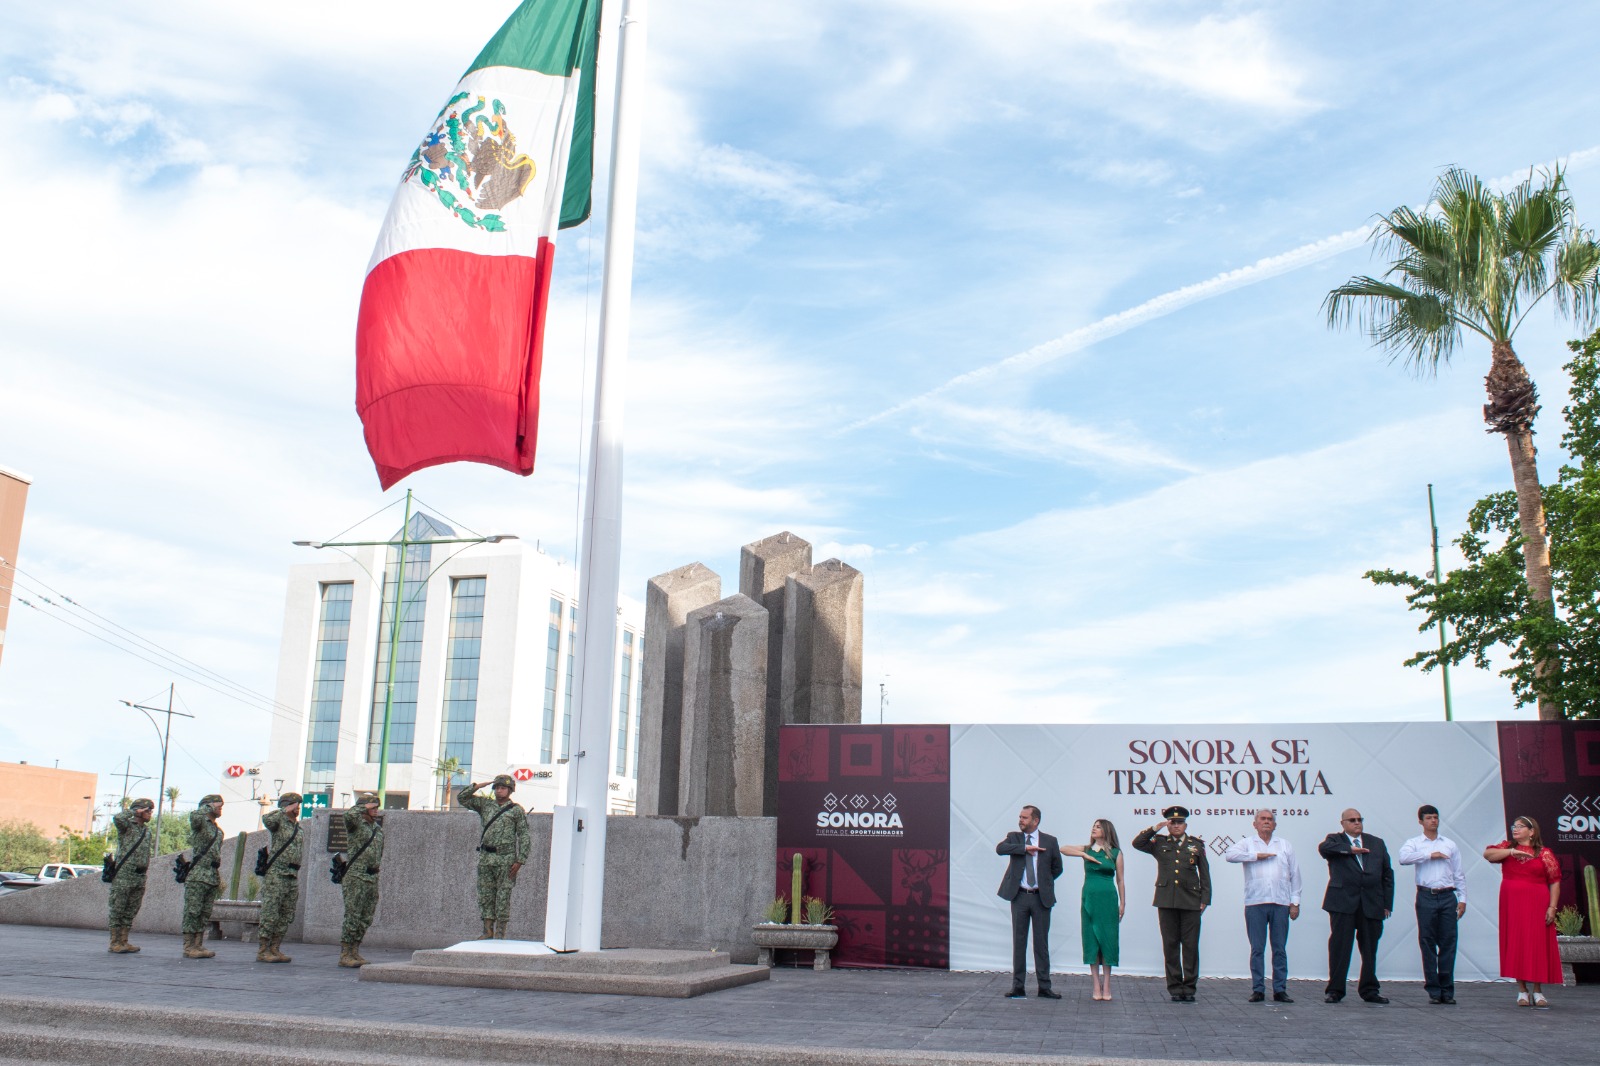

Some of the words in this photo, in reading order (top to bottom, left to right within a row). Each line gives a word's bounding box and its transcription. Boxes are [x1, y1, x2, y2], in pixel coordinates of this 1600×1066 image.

[1128, 739, 1263, 765] SONORA
[1271, 739, 1310, 765] SE
[1108, 769, 1333, 796] TRANSFORMA
[816, 811, 904, 828] SONORA
[1134, 808, 1156, 816] MES
[1161, 808, 1202, 816] PIO
[1206, 808, 1278, 816] SEPTIEME
[1282, 808, 1310, 816] 2026
